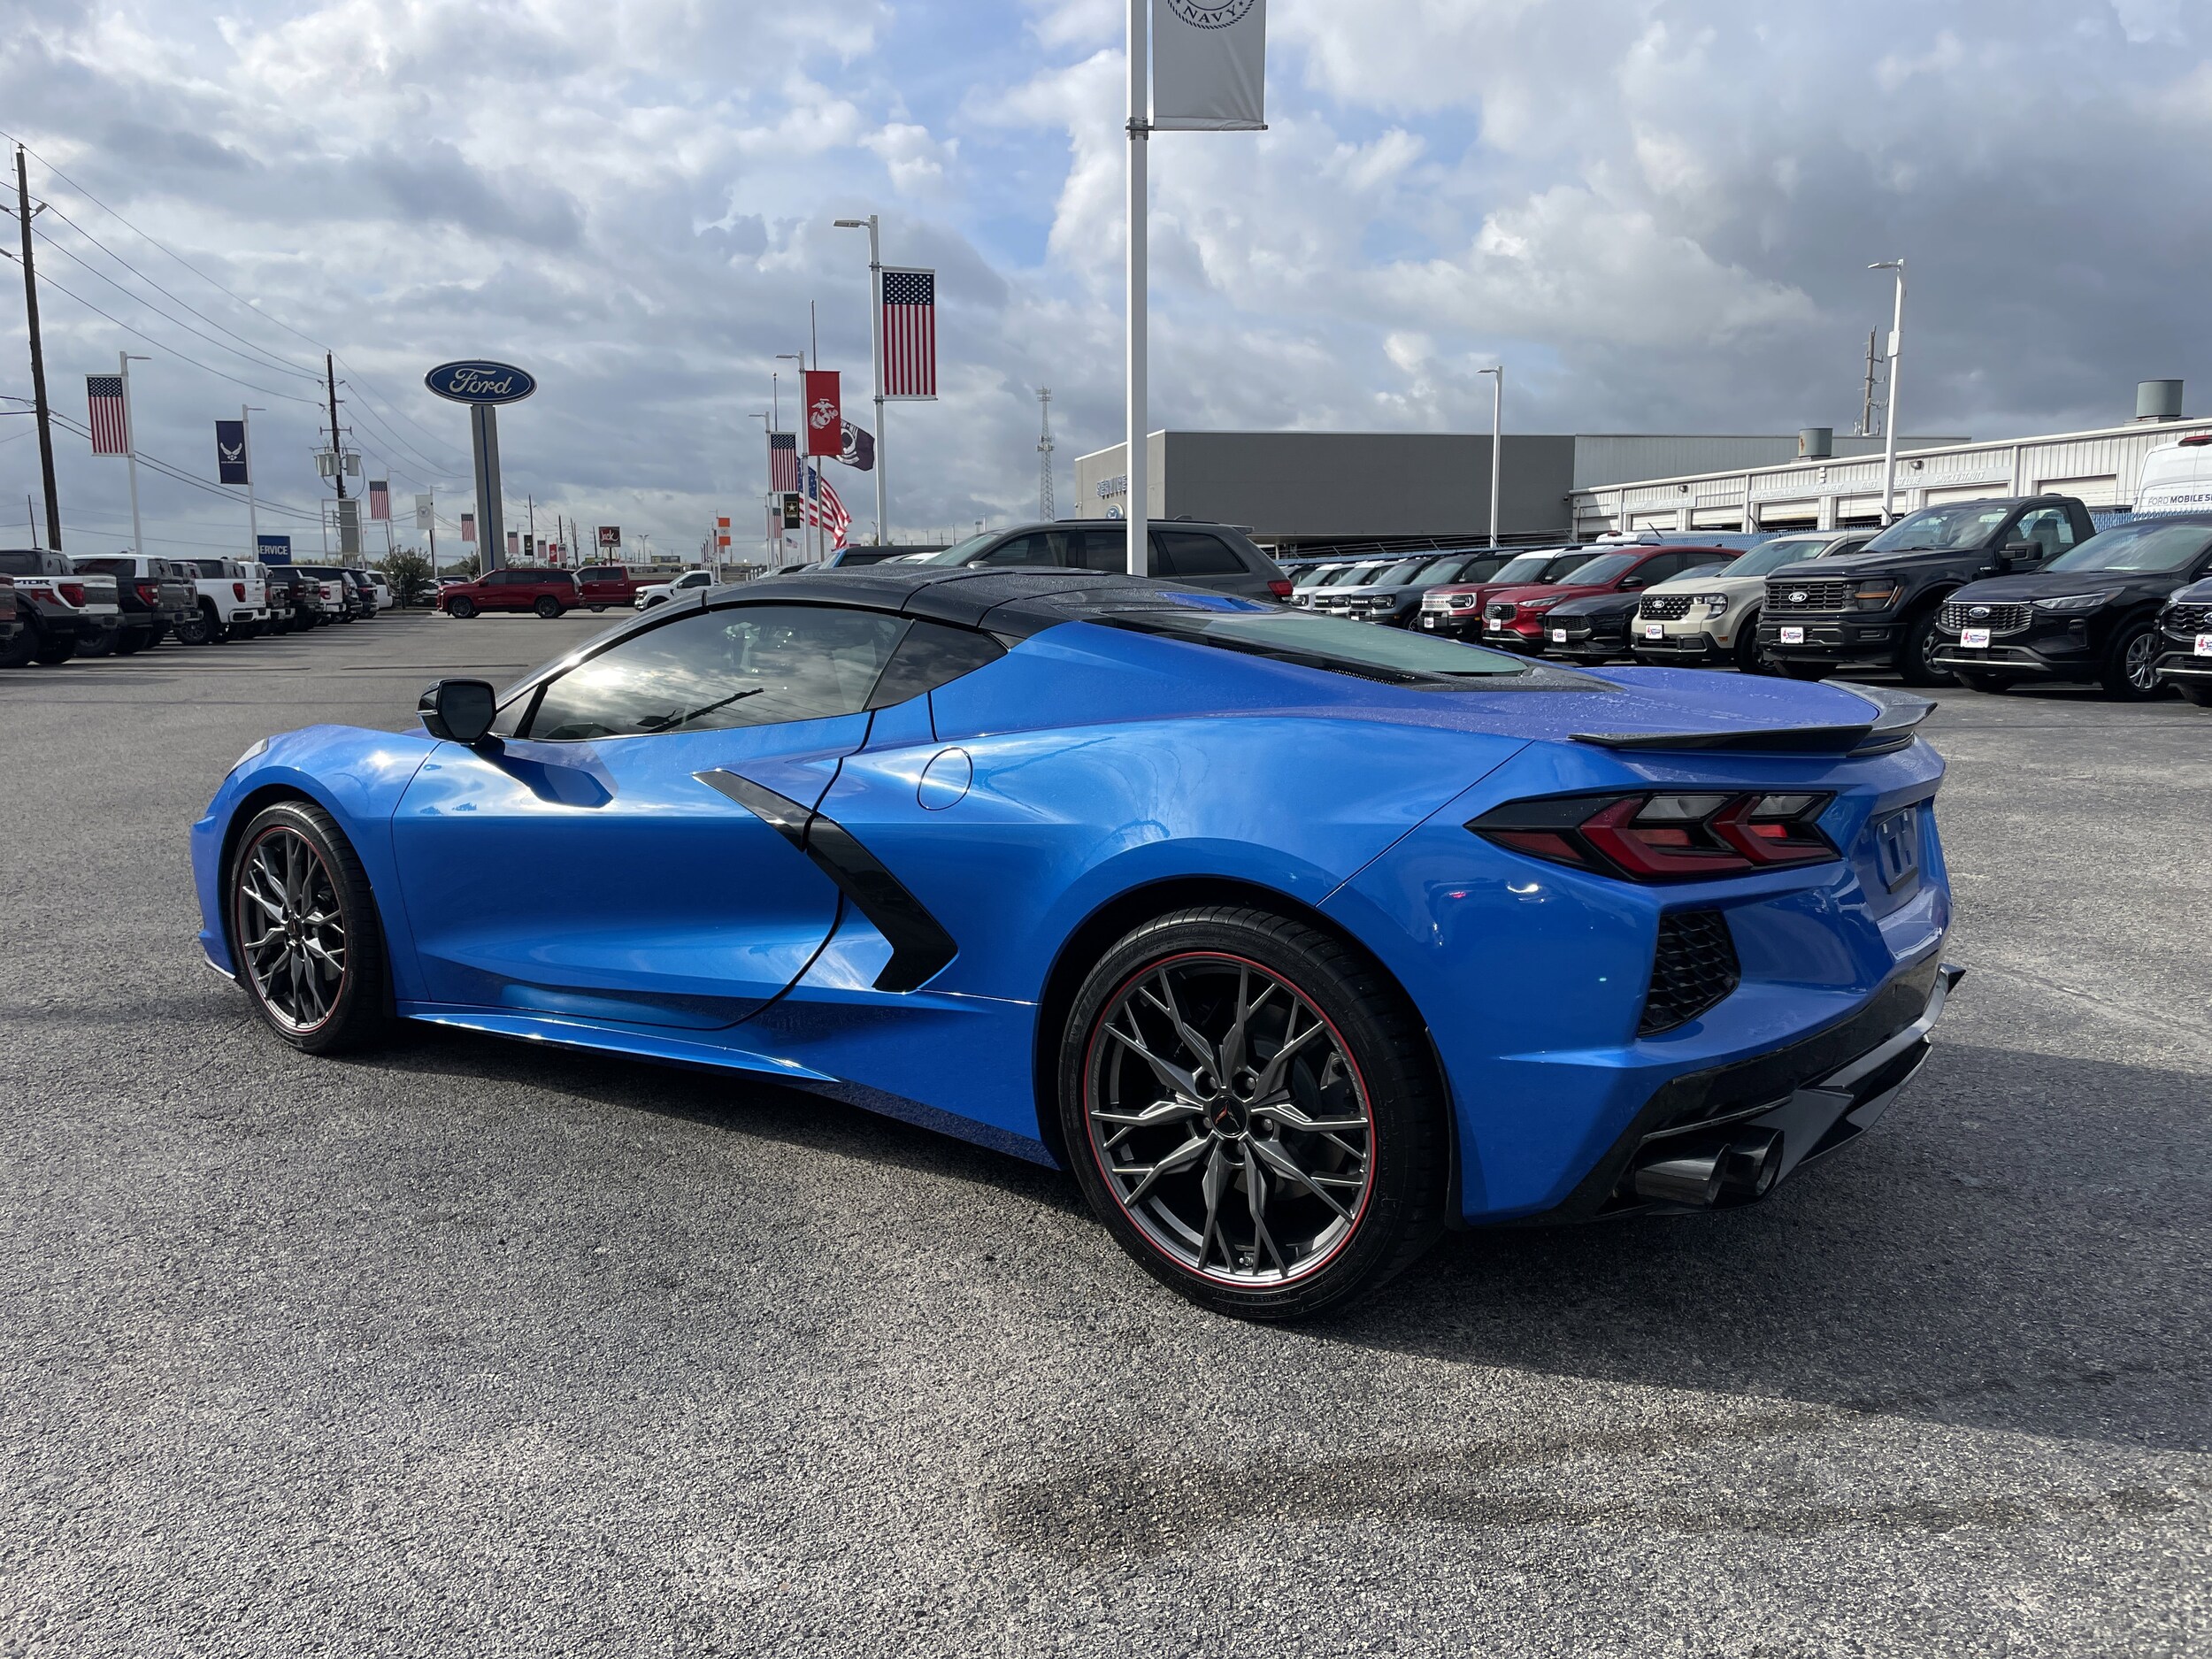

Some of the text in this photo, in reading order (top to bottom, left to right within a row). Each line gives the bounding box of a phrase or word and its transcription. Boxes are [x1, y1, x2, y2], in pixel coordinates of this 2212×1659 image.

[1183, 4, 1236, 24] NAVY
[449, 368, 513, 395] Ford
[1096, 474, 1127, 496] SERVICE
[1861, 480, 1878, 490] TIRES
[2148, 496, 2169, 505] FORD
[2170, 494, 2204, 504] MOBILE
[257, 545, 288, 555] ERVICE
